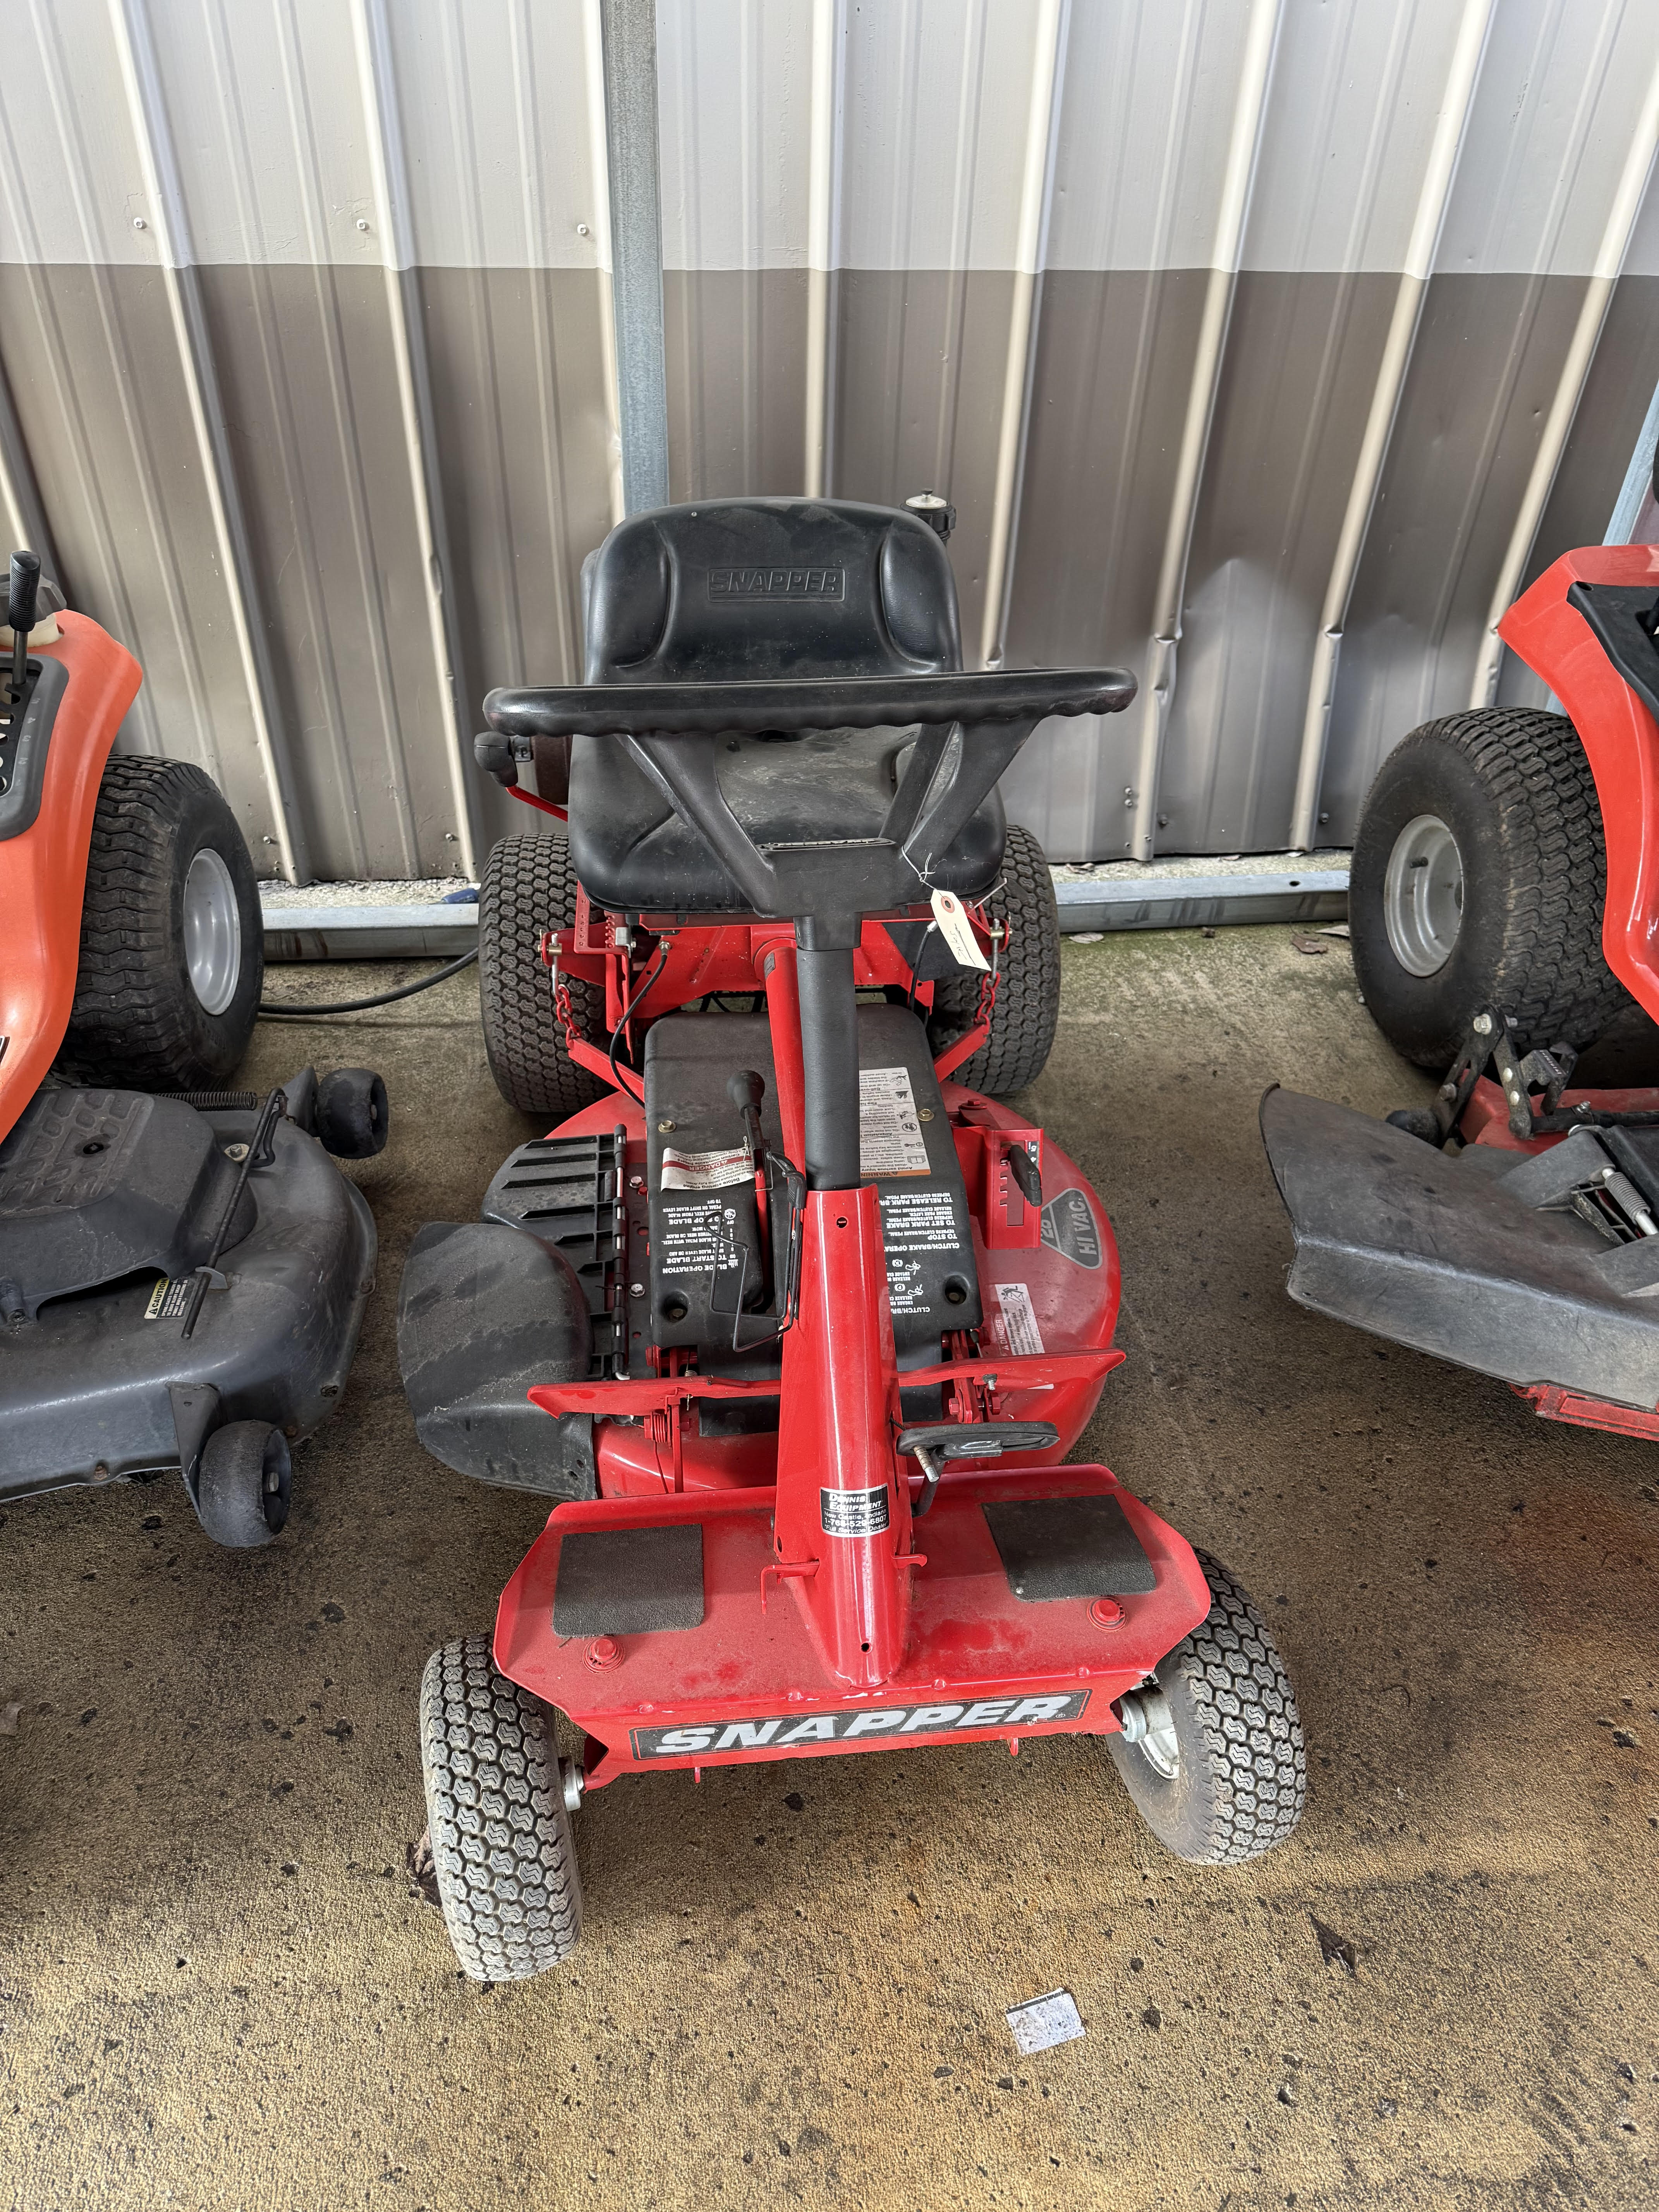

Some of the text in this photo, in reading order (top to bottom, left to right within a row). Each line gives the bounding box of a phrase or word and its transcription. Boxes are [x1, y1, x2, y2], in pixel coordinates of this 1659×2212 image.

[711, 571, 840, 592] SNAPPER
[1068, 1198, 1097, 1255] HI VAC.
[663, 1266, 703, 1274] OPERATION
[152, 1279, 167, 1307] CAUTION
[996, 1320, 1007, 1344] DANGER
[829, 1493, 866, 1503] DENNIS
[830, 1501, 882, 1511] EQUIPMENT
[655, 1696, 1072, 1753] SNAPPER
